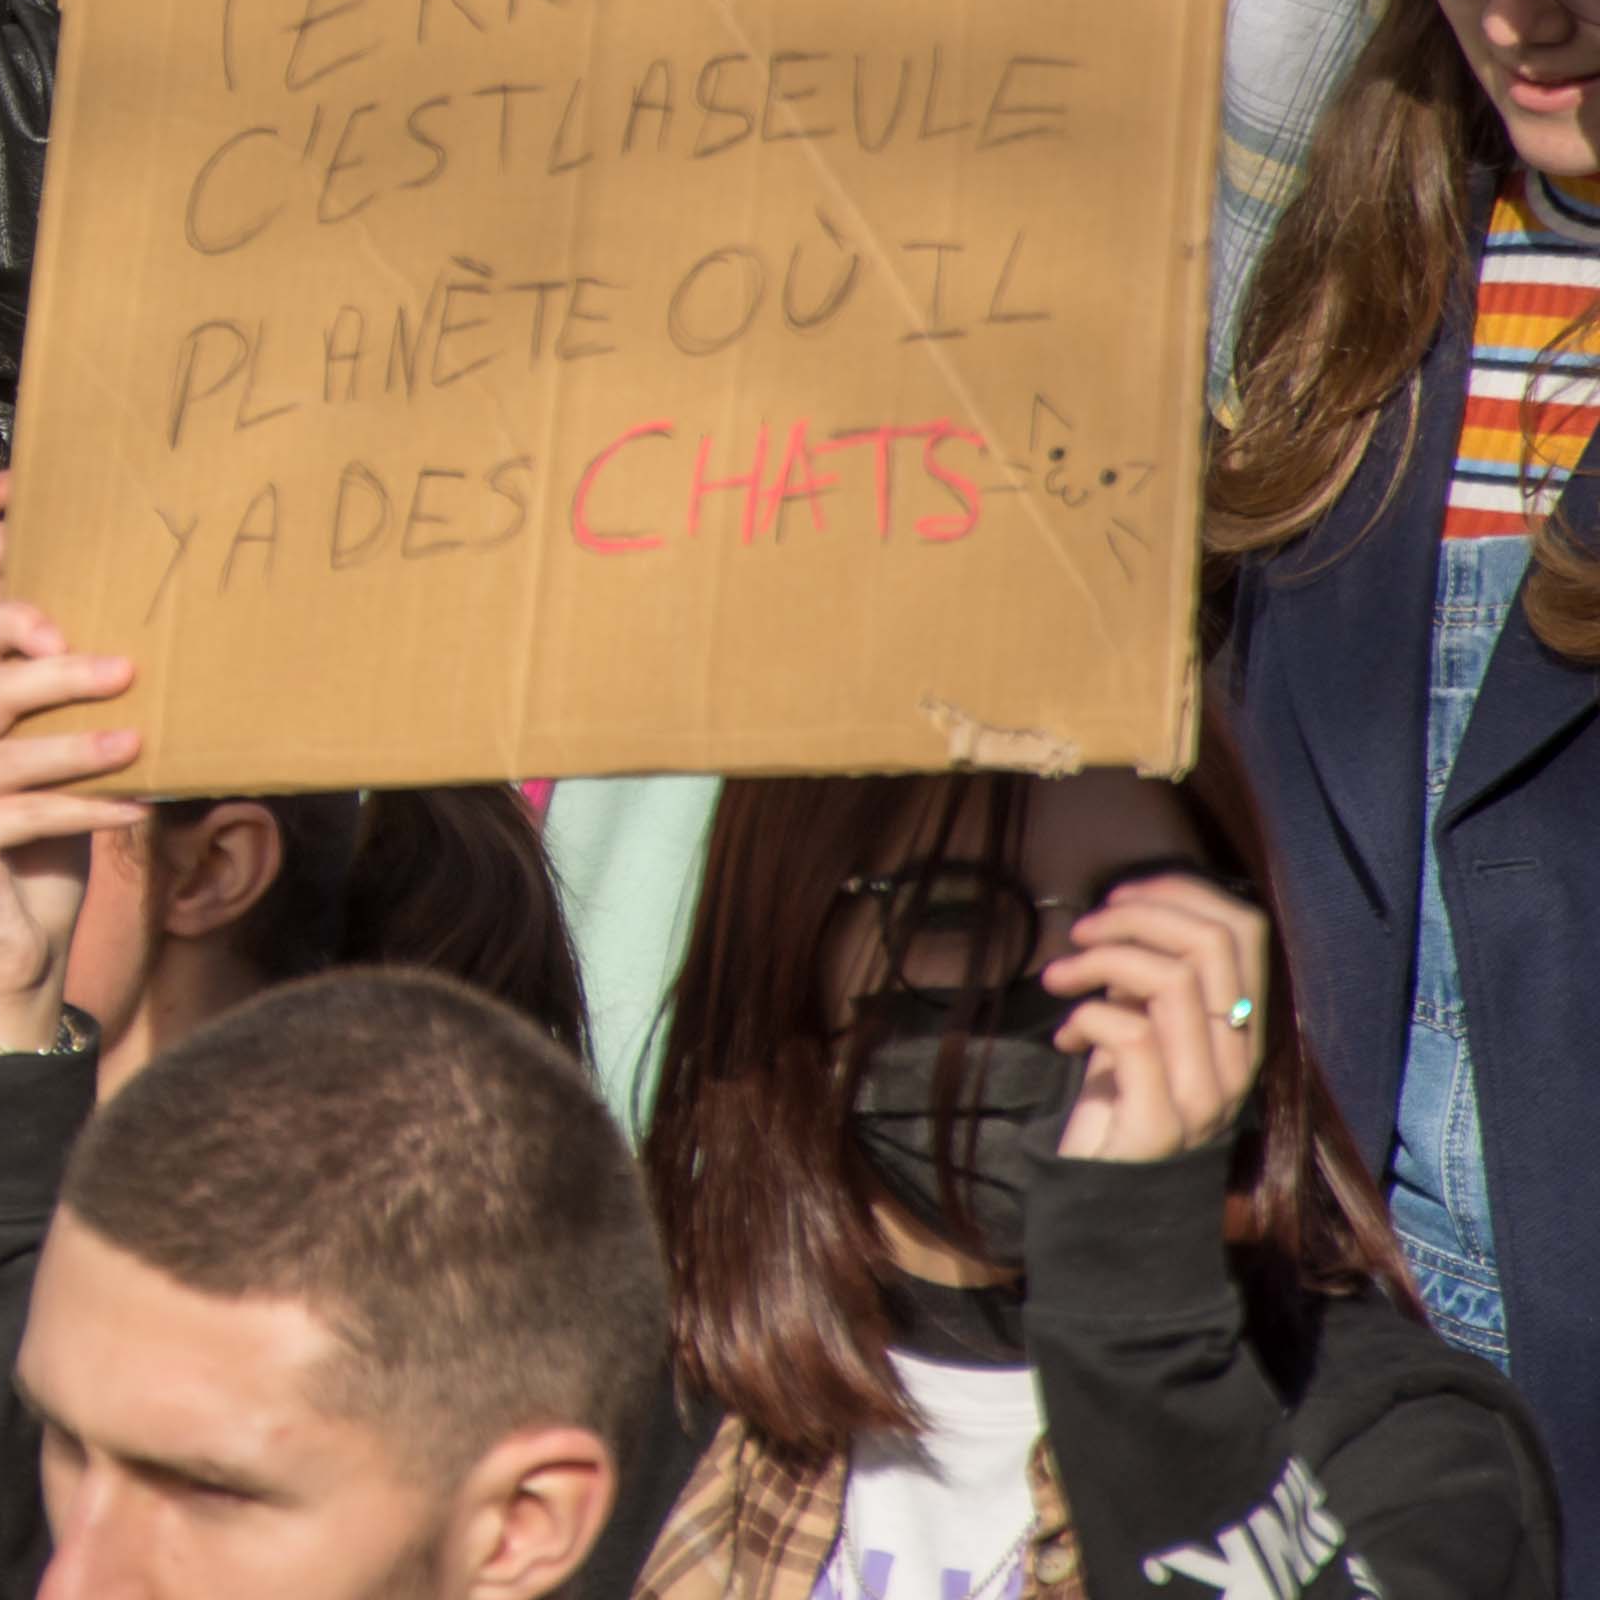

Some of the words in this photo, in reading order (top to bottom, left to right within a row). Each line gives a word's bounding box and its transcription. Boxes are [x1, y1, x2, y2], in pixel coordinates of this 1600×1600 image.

[168, 255, 627, 449] PLANÈTE
[900, 230, 1053, 342] IL
[570, 416, 986, 555] CHATS
